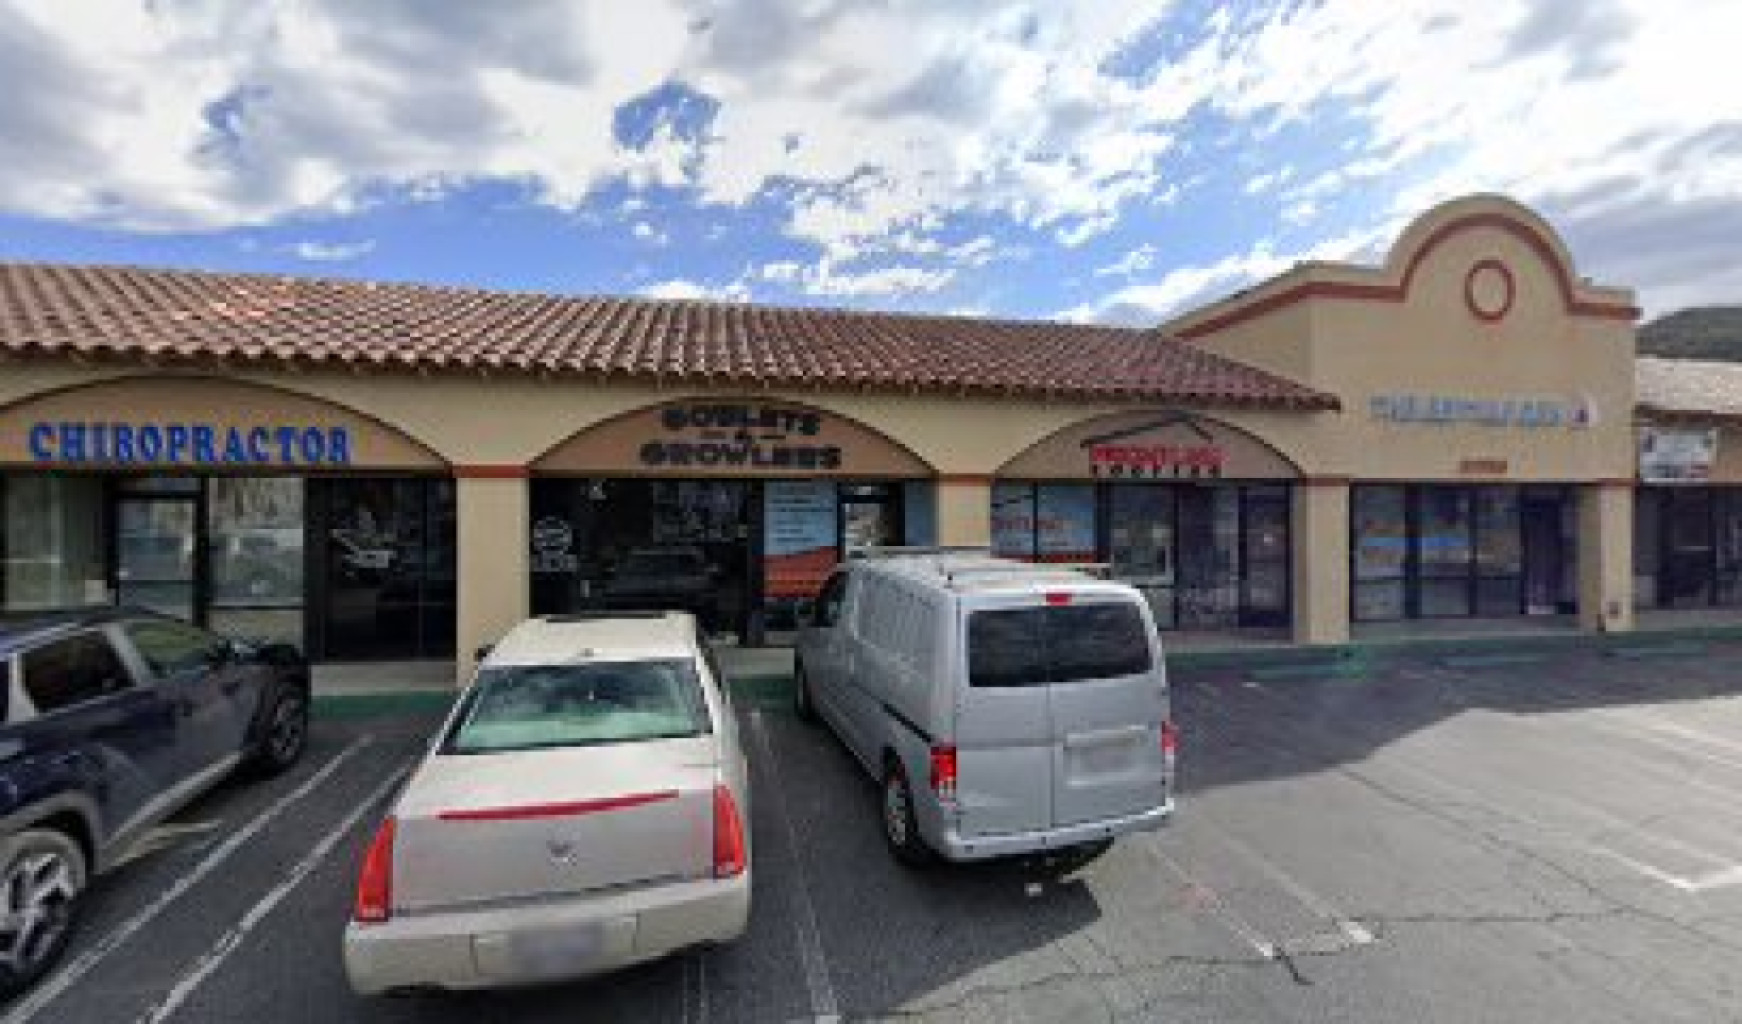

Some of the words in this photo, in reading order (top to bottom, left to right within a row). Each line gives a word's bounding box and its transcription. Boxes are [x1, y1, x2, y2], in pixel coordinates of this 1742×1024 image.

[662, 407, 821, 437] GOBLETS
[29, 421, 351, 464] CHIROPRACTOR
[640, 441, 842, 469] GROWLERS
